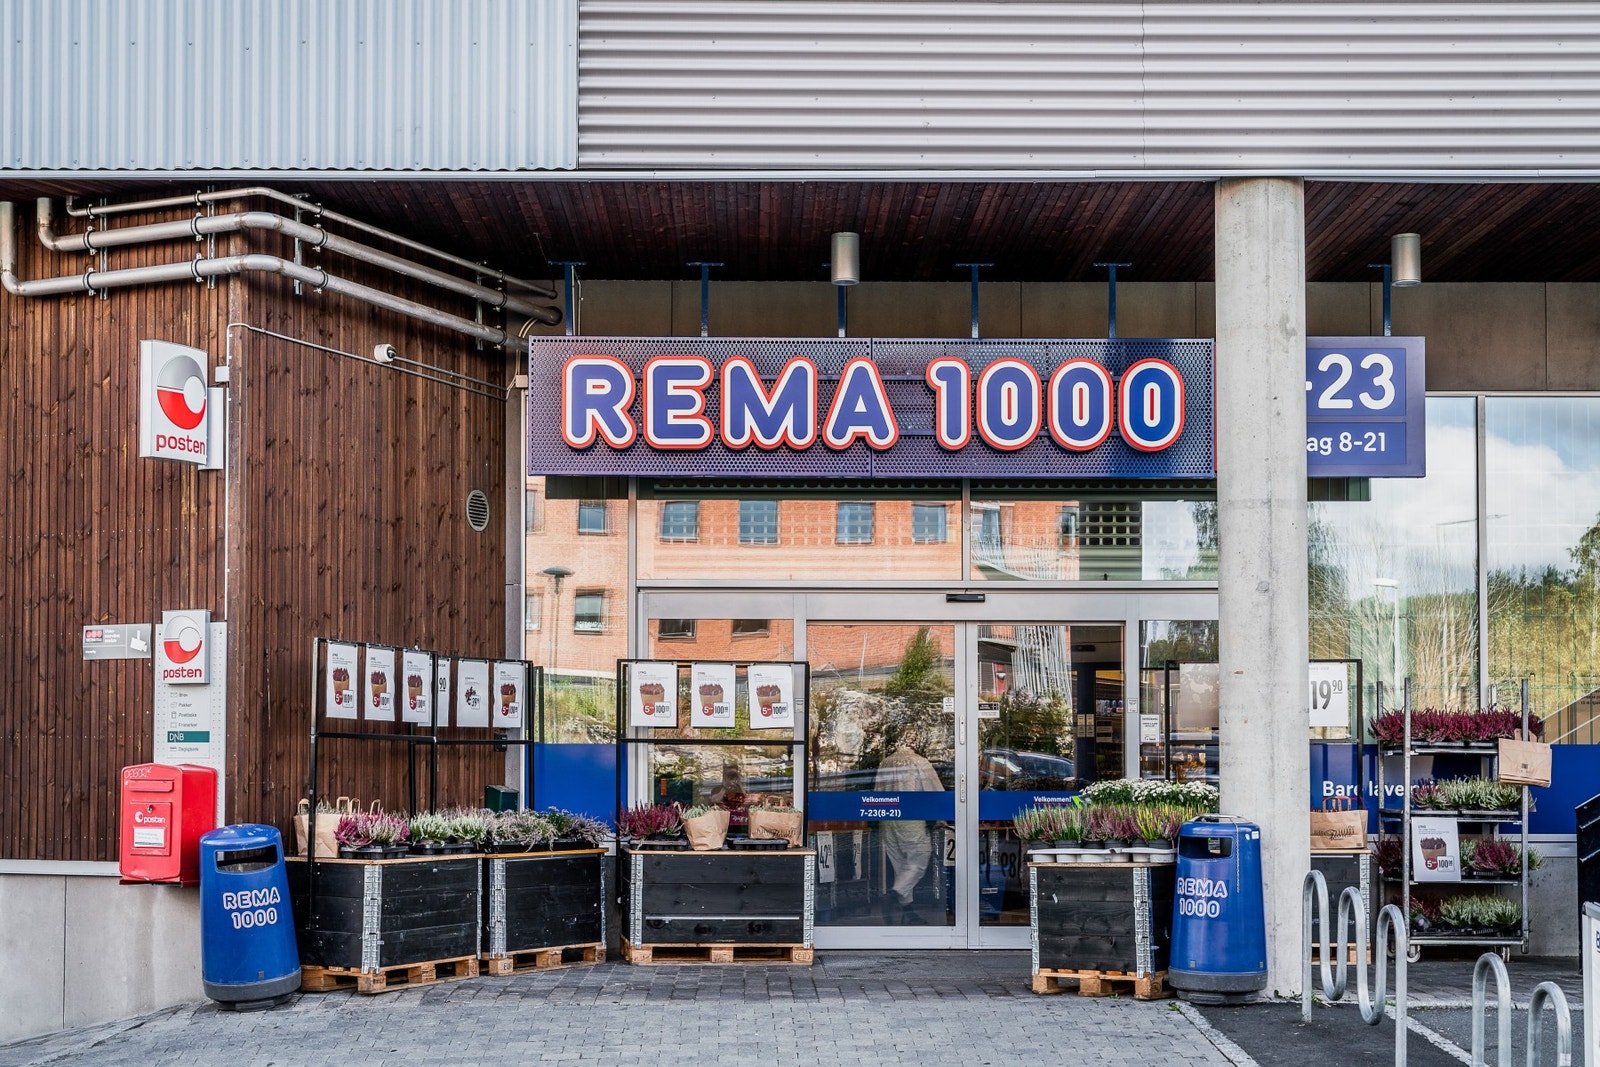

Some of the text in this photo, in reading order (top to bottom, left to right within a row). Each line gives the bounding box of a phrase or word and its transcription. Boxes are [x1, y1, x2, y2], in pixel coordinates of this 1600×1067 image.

[1306, 353, 1395, 410] 23
[562, 355, 1185, 451] REMA 1000
[156, 434, 206, 455] posten
[1339, 432, 1385, 452] 8-21
[162, 667, 203, 681] posten
[169, 730, 185, 743] DNB
[143, 815, 166, 825] posten
[860, 809, 902, 818] 7-23(8-21)
[223, 886, 280, 910] REMA
[1177, 877, 1228, 899] REMA
[231, 907, 278, 929] 1000
[1180, 898, 1220, 919] 1000
